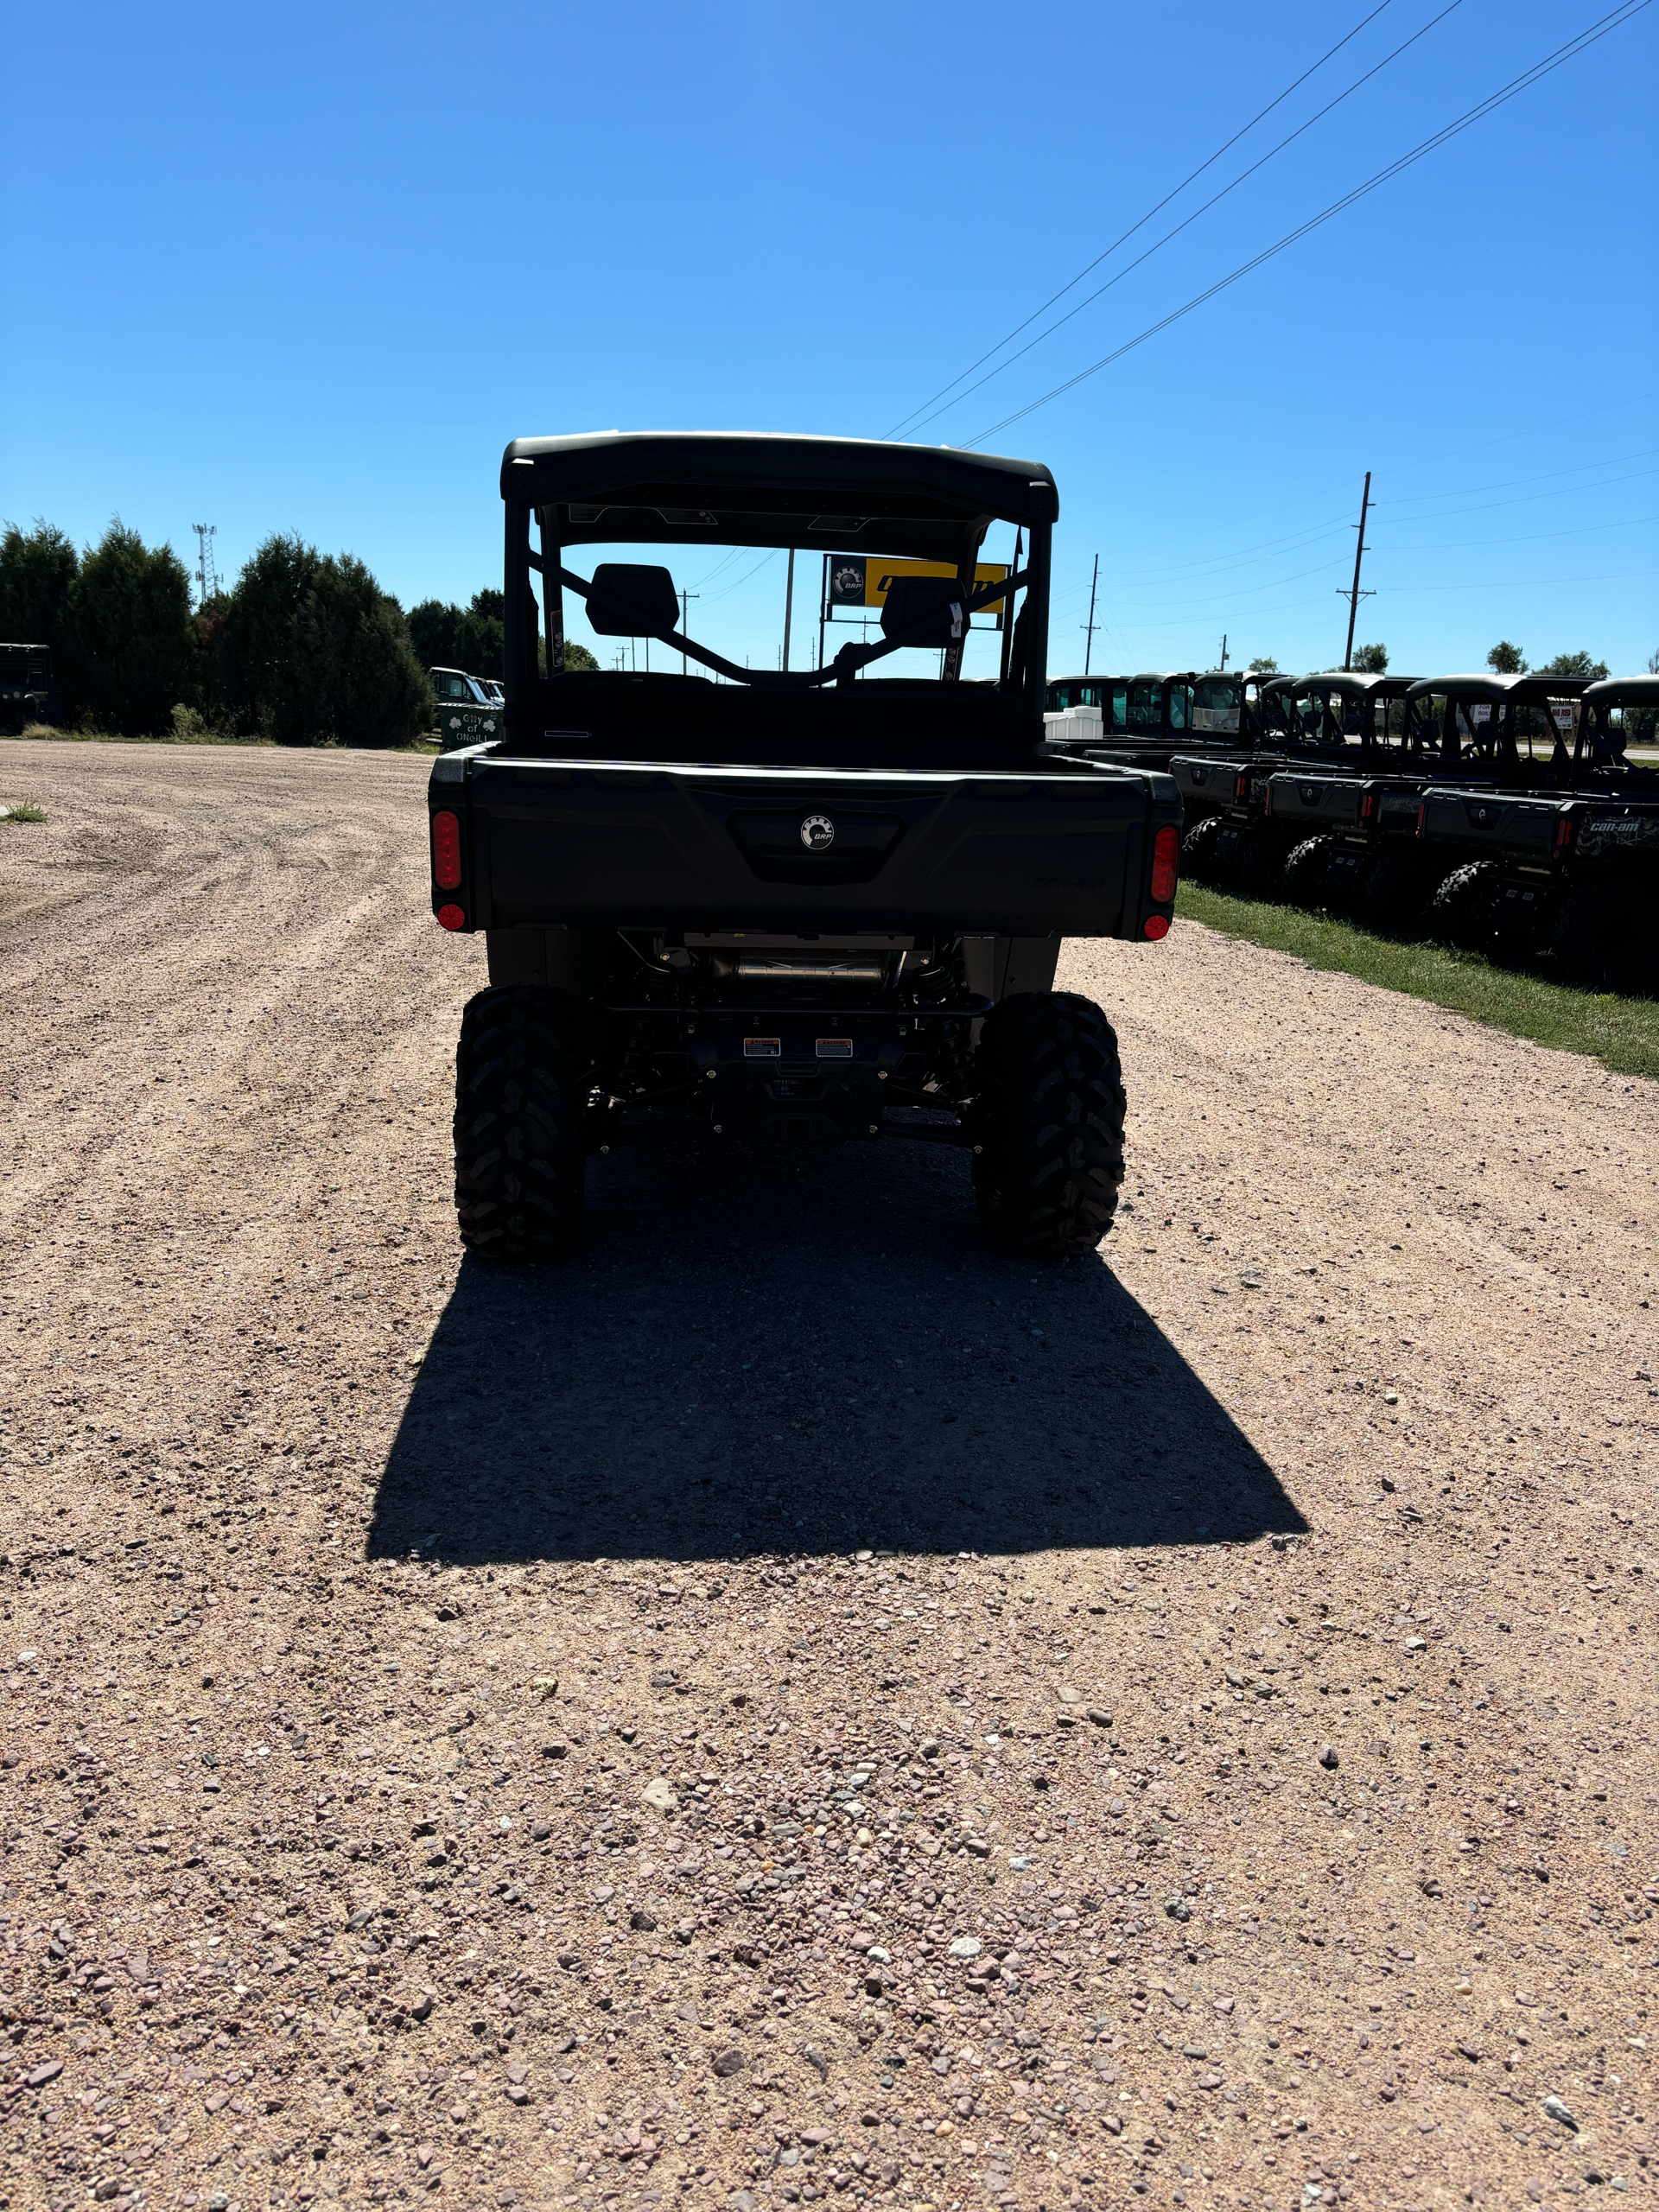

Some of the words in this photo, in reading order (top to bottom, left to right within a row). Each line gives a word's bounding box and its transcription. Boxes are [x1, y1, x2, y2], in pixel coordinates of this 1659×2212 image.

[844, 582, 861, 590] BRP
[467, 724, 479, 733] of
[1590, 823, 1639, 832] can-am
